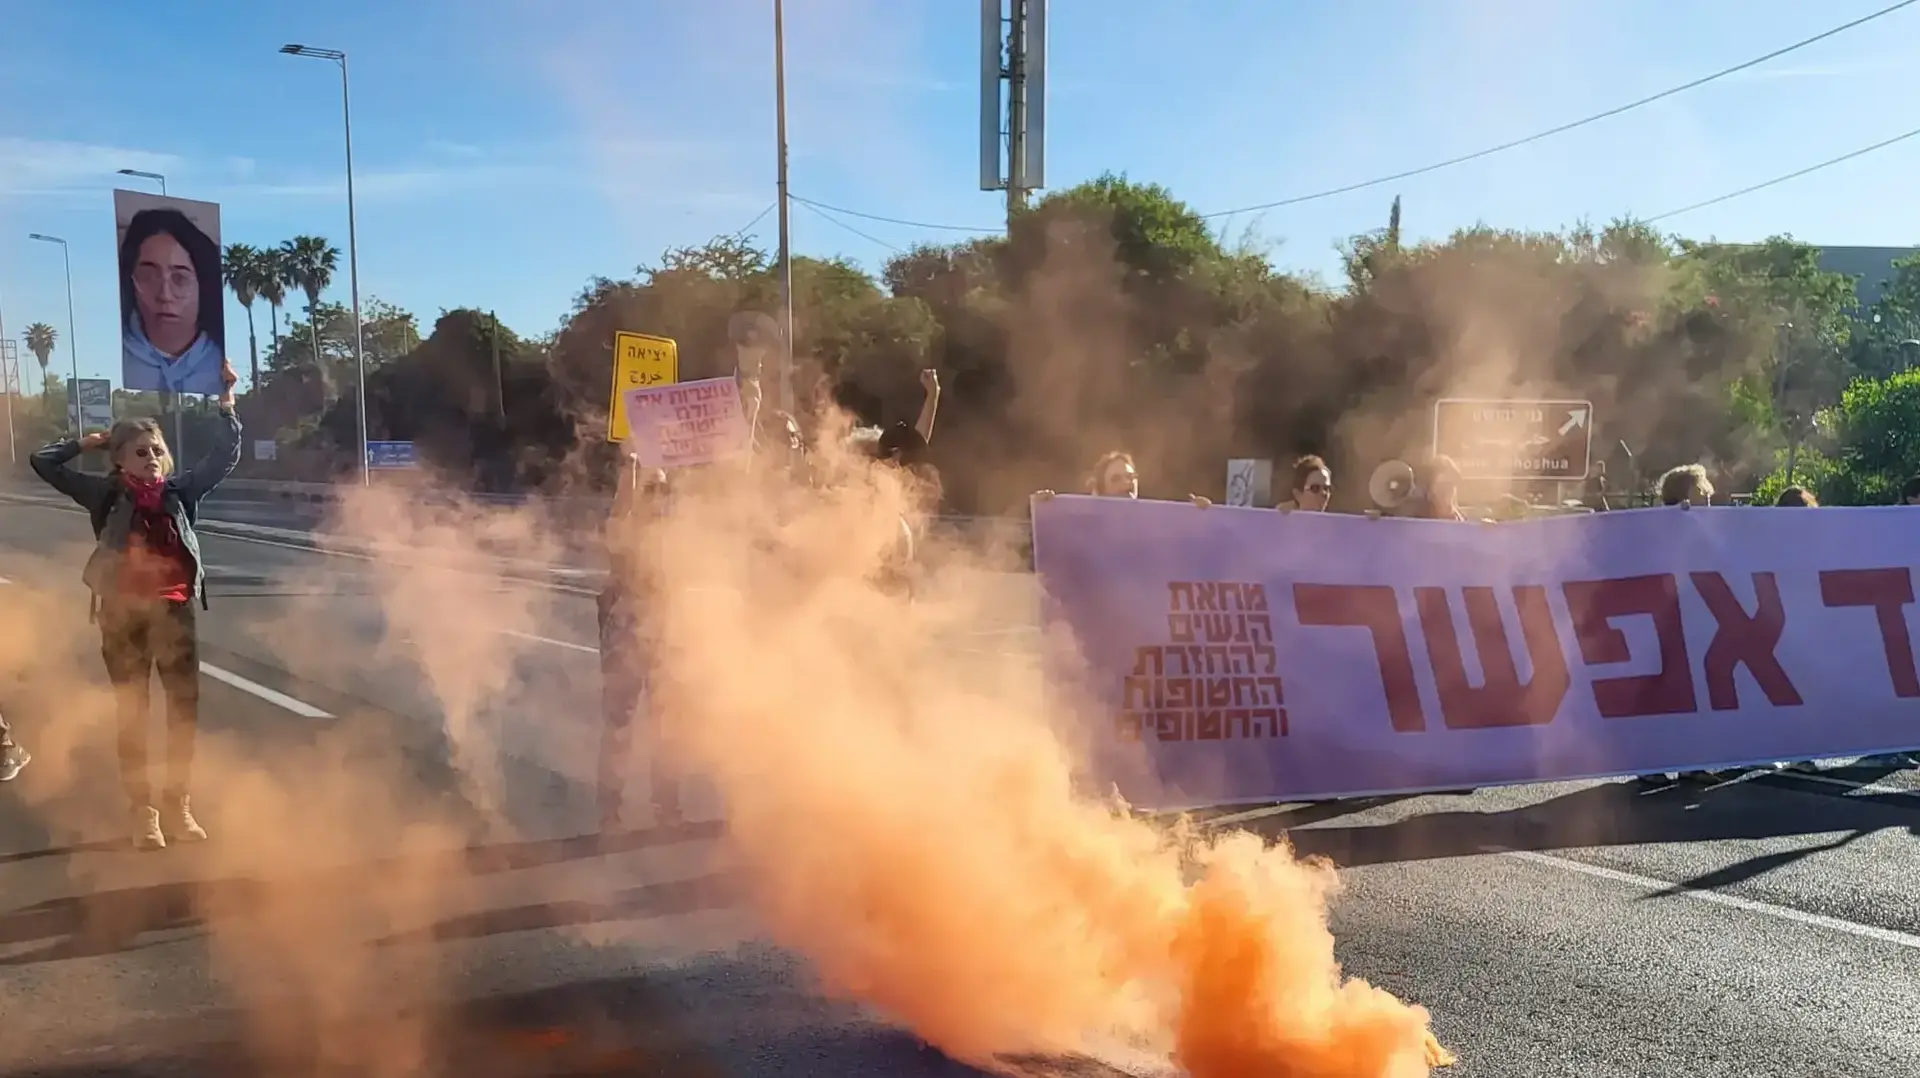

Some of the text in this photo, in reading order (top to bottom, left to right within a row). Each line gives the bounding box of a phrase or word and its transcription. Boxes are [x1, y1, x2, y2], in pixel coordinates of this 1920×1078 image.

[627, 345, 667, 362] יציאה
[630, 370, 663, 385] خروج
[635, 383, 732, 410] עוצרות את
[1498, 457, 1569, 470] hoshua
[1167, 581, 1269, 612] מחאת
[1167, 613, 1273, 643] הנשים
[1133, 644, 1277, 676] להחזרת
[1293, 571, 1804, 732] אפשר
[1123, 676, 1285, 709] החטופות
[1115, 708, 1289, 742] והחטופים
